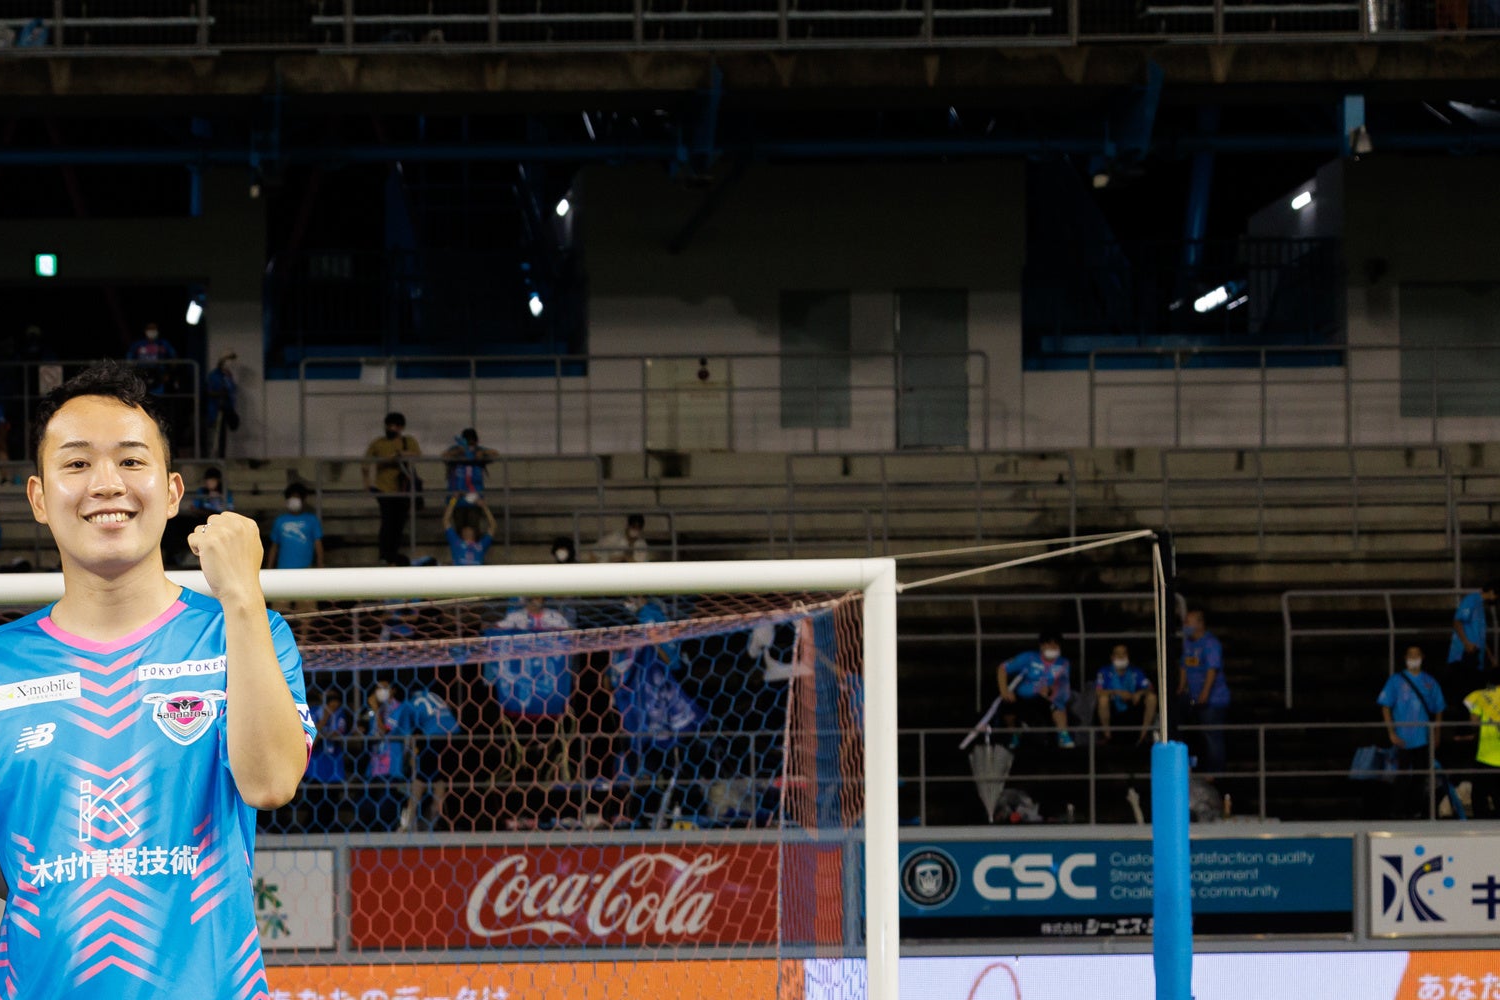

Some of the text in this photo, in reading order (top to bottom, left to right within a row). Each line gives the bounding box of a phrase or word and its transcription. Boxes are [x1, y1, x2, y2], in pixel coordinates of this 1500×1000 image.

[142, 659, 227, 677] TOKYO TOKEN
[29, 846, 198, 888] 木村情報技術
[972, 853, 1097, 900] CSC
[1189, 851, 1263, 866] atisfaction
[1266, 851, 1315, 866] quality
[466, 852, 729, 937] Coca-Cola
